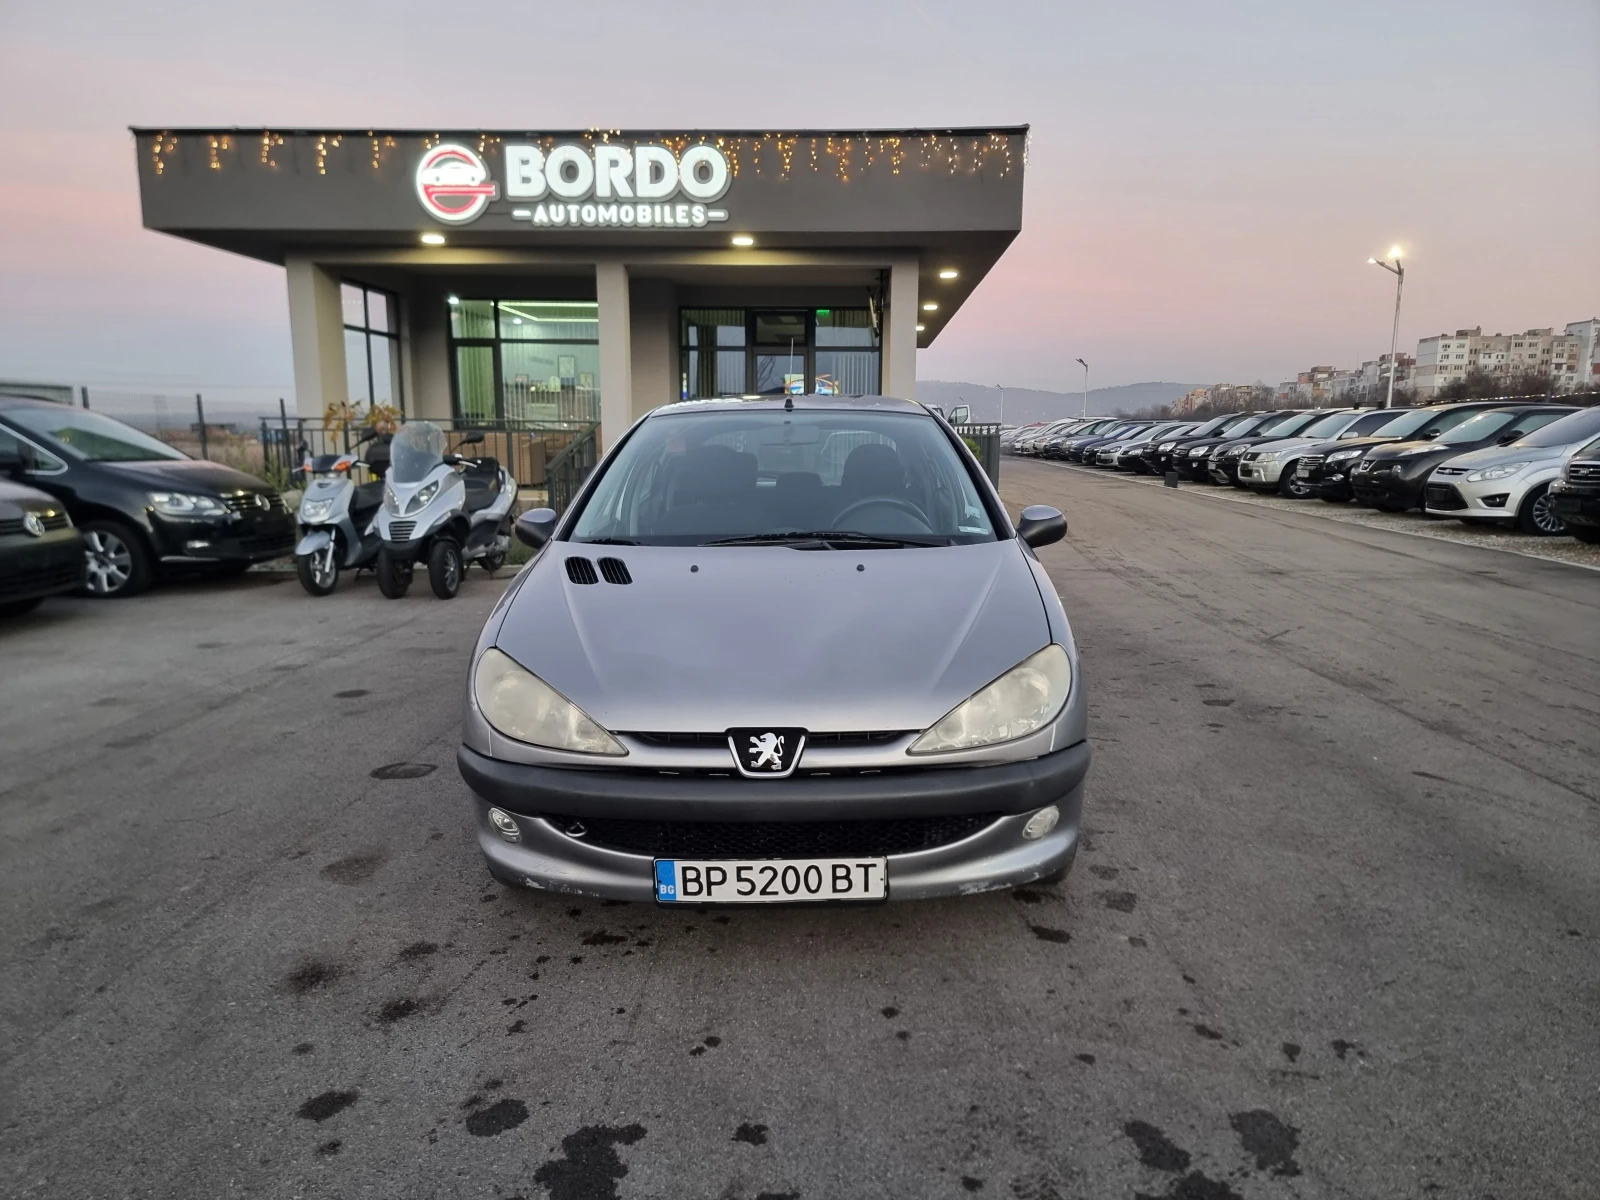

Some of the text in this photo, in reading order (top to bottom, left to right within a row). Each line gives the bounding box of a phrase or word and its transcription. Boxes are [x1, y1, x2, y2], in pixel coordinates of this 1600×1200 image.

[505, 145, 728, 198] BORDO
[533, 204, 705, 224] AUTOMOBILES
[660, 884, 675, 895] BG
[681, 863, 877, 896] BP 5200 BT
